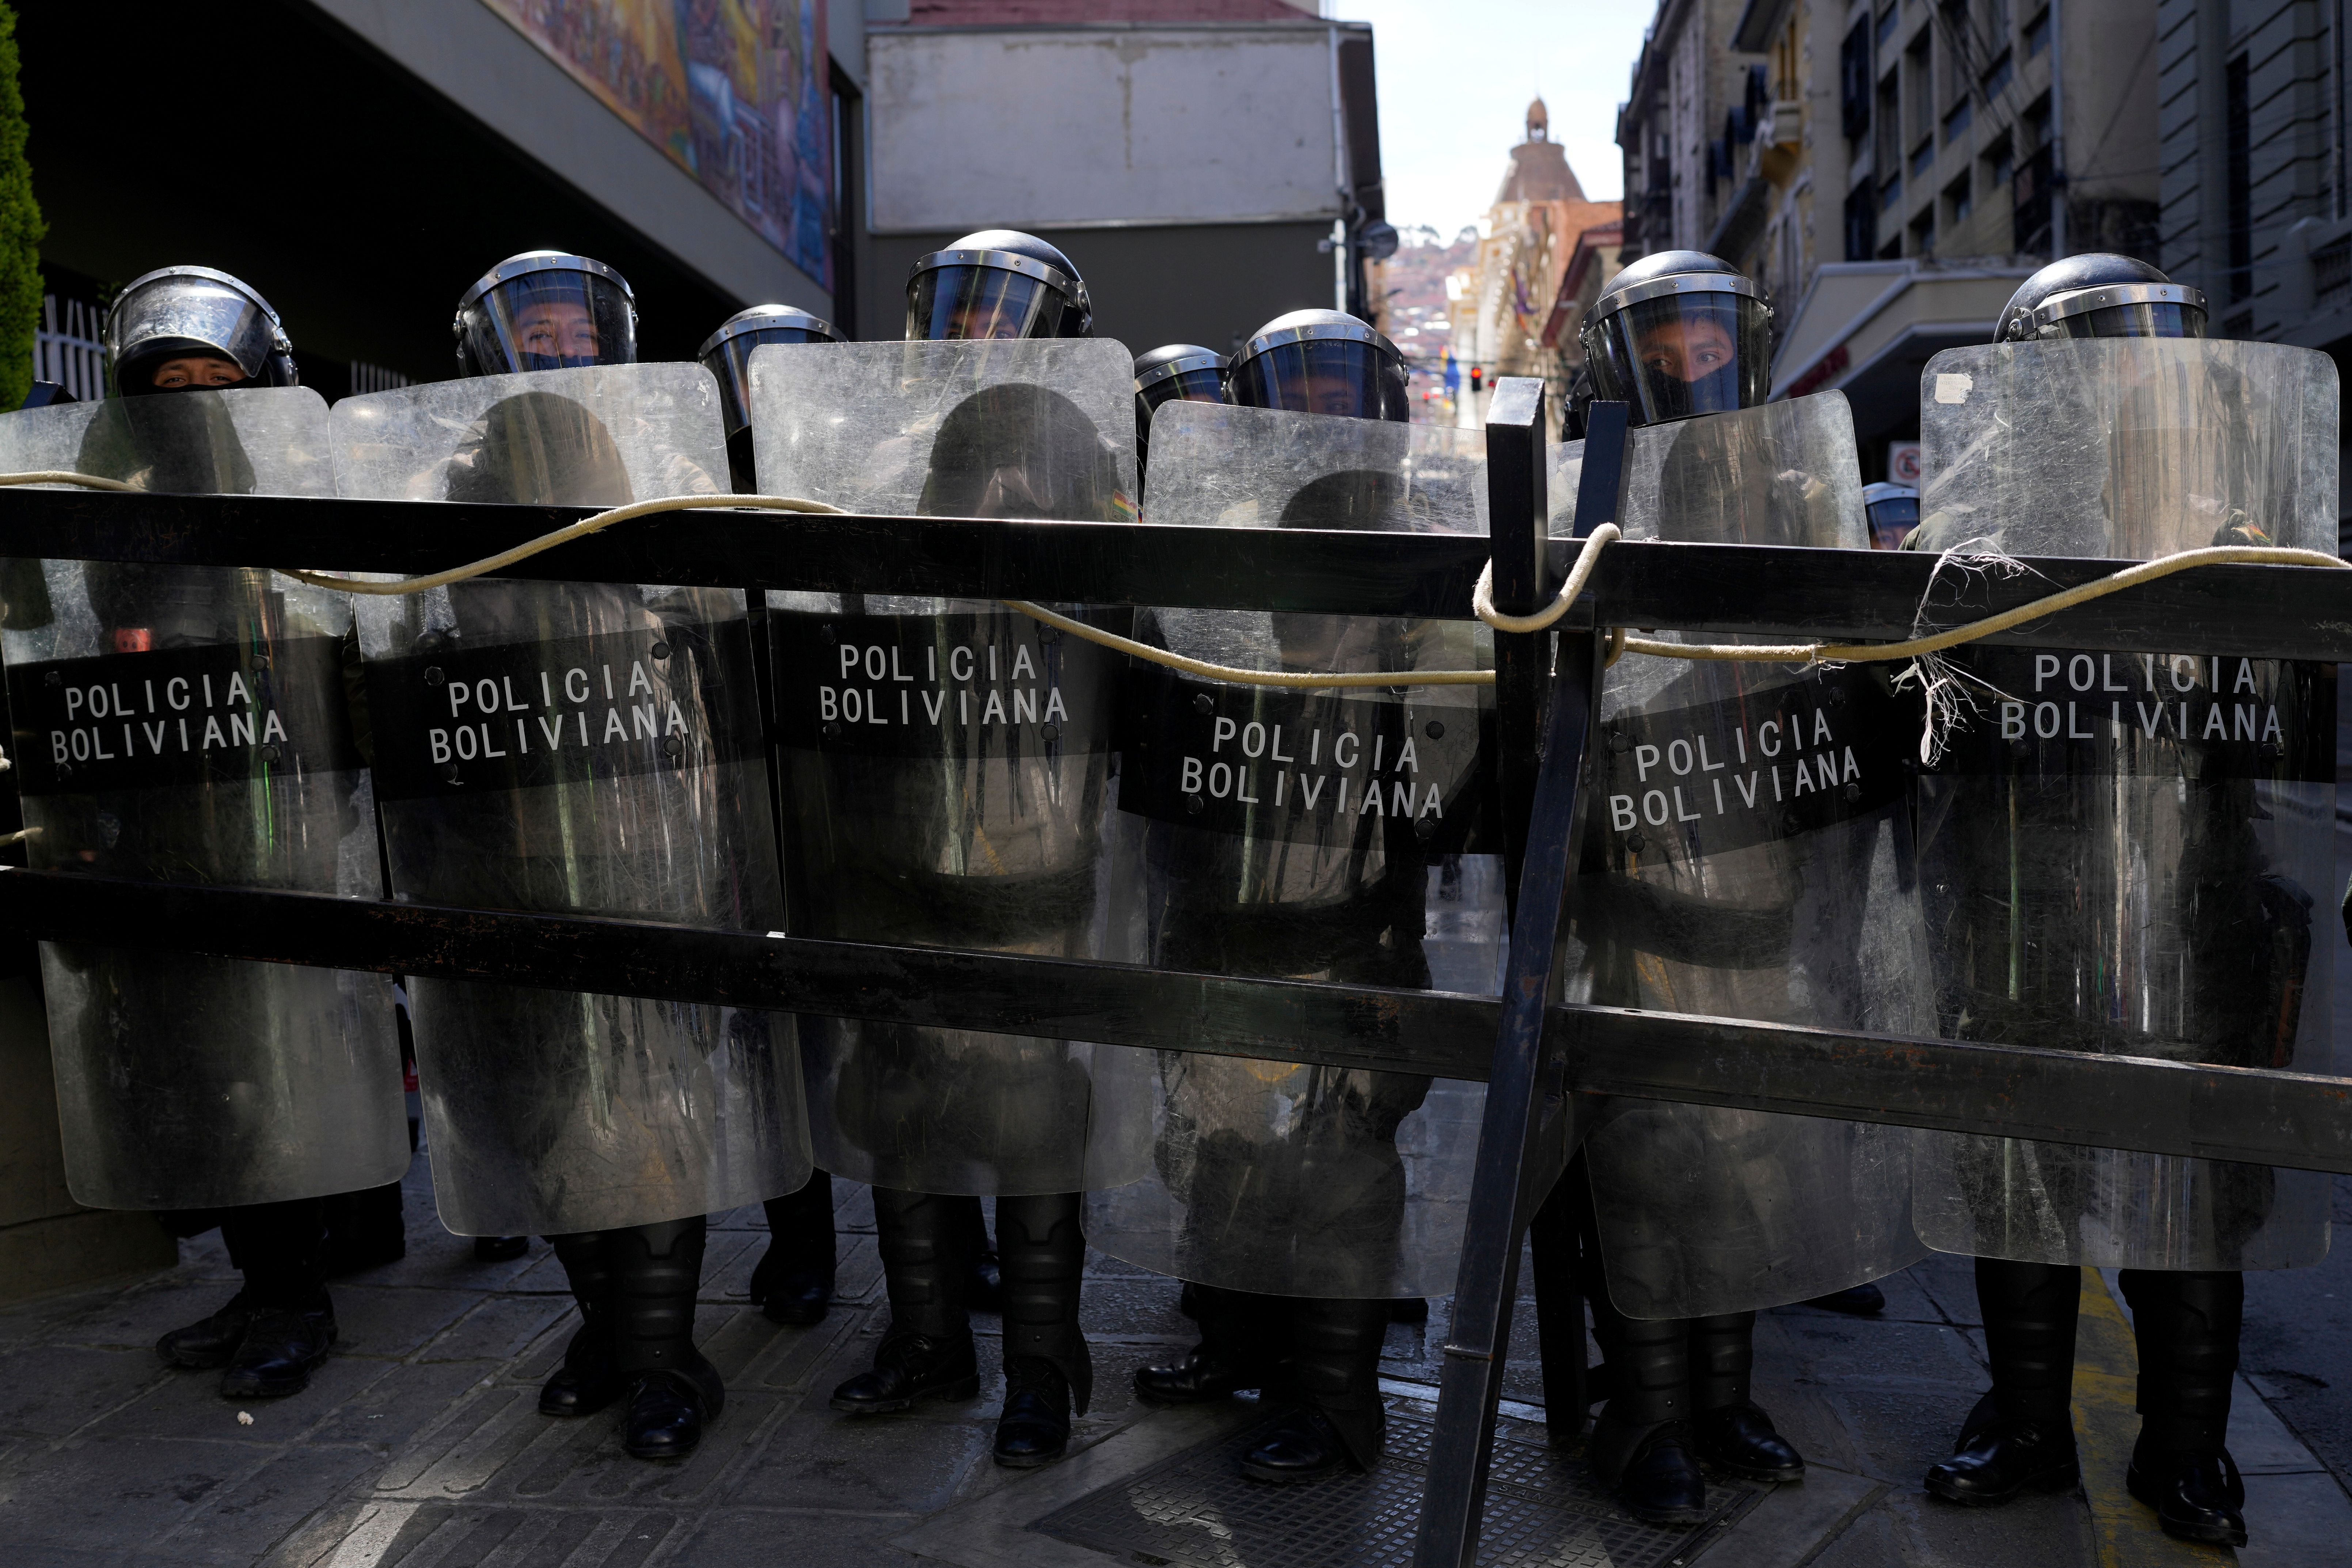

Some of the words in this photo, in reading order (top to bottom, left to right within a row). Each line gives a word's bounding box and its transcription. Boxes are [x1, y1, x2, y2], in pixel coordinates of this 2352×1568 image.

[448, 661, 653, 717] POLICIA
[841, 644, 1036, 681] POLICIA
[2035, 654, 2257, 694] POLICIA
[65, 671, 252, 721] POLICIA
[820, 686, 1068, 725] BOLIVIANA
[2001, 701, 2284, 742] BOLIVIANA
[50, 709, 288, 764] BOLIVIANA
[429, 701, 689, 764] BOLIVIANA
[1213, 716, 1418, 773] POLICIA
[1635, 707, 1833, 782] POLICIA
[1181, 756, 1443, 819] BOLIVIANA
[1609, 745, 1861, 832] BOLIVIANA
